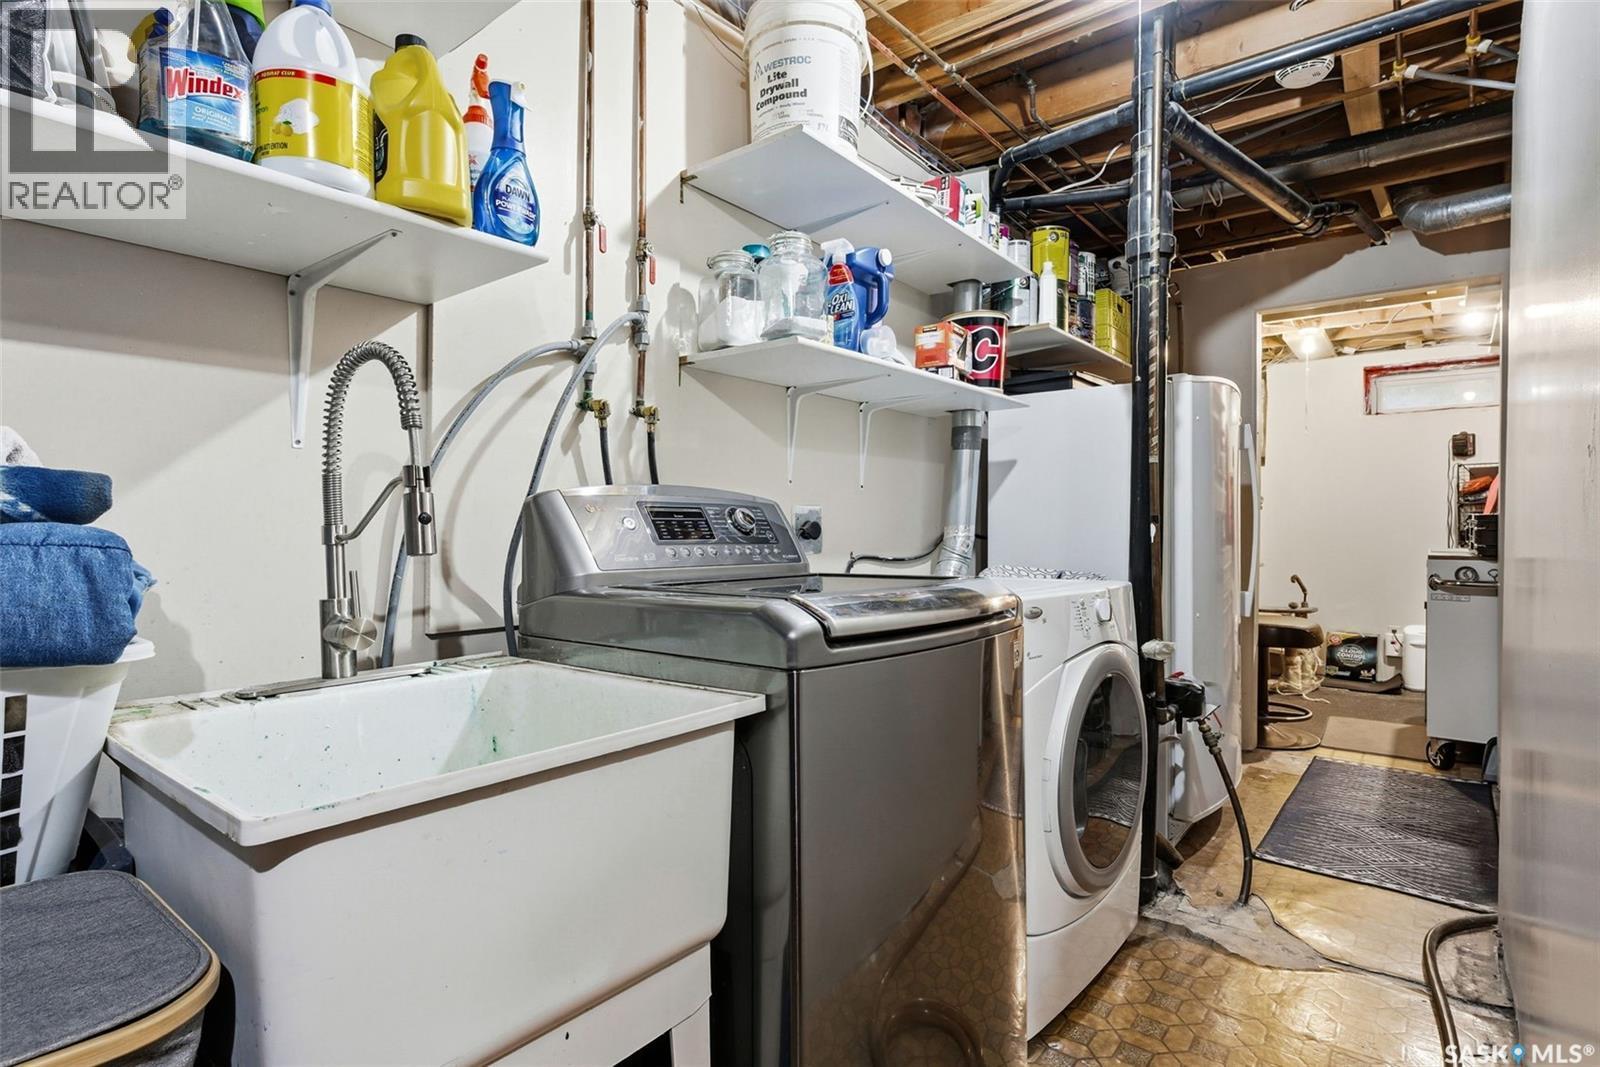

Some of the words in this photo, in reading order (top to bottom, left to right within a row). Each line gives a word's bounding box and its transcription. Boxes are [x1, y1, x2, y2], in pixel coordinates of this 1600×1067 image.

[764, 55, 812, 73] WESTROC
[165, 66, 246, 102] Windex
[767, 70, 787, 84] Lite
[760, 78, 799, 98] Drywall
[756, 88, 807, 111] Compound
[505, 184, 531, 202] DAWN
[831, 293, 848, 306] OXI
[968, 326, 1001, 374] C
